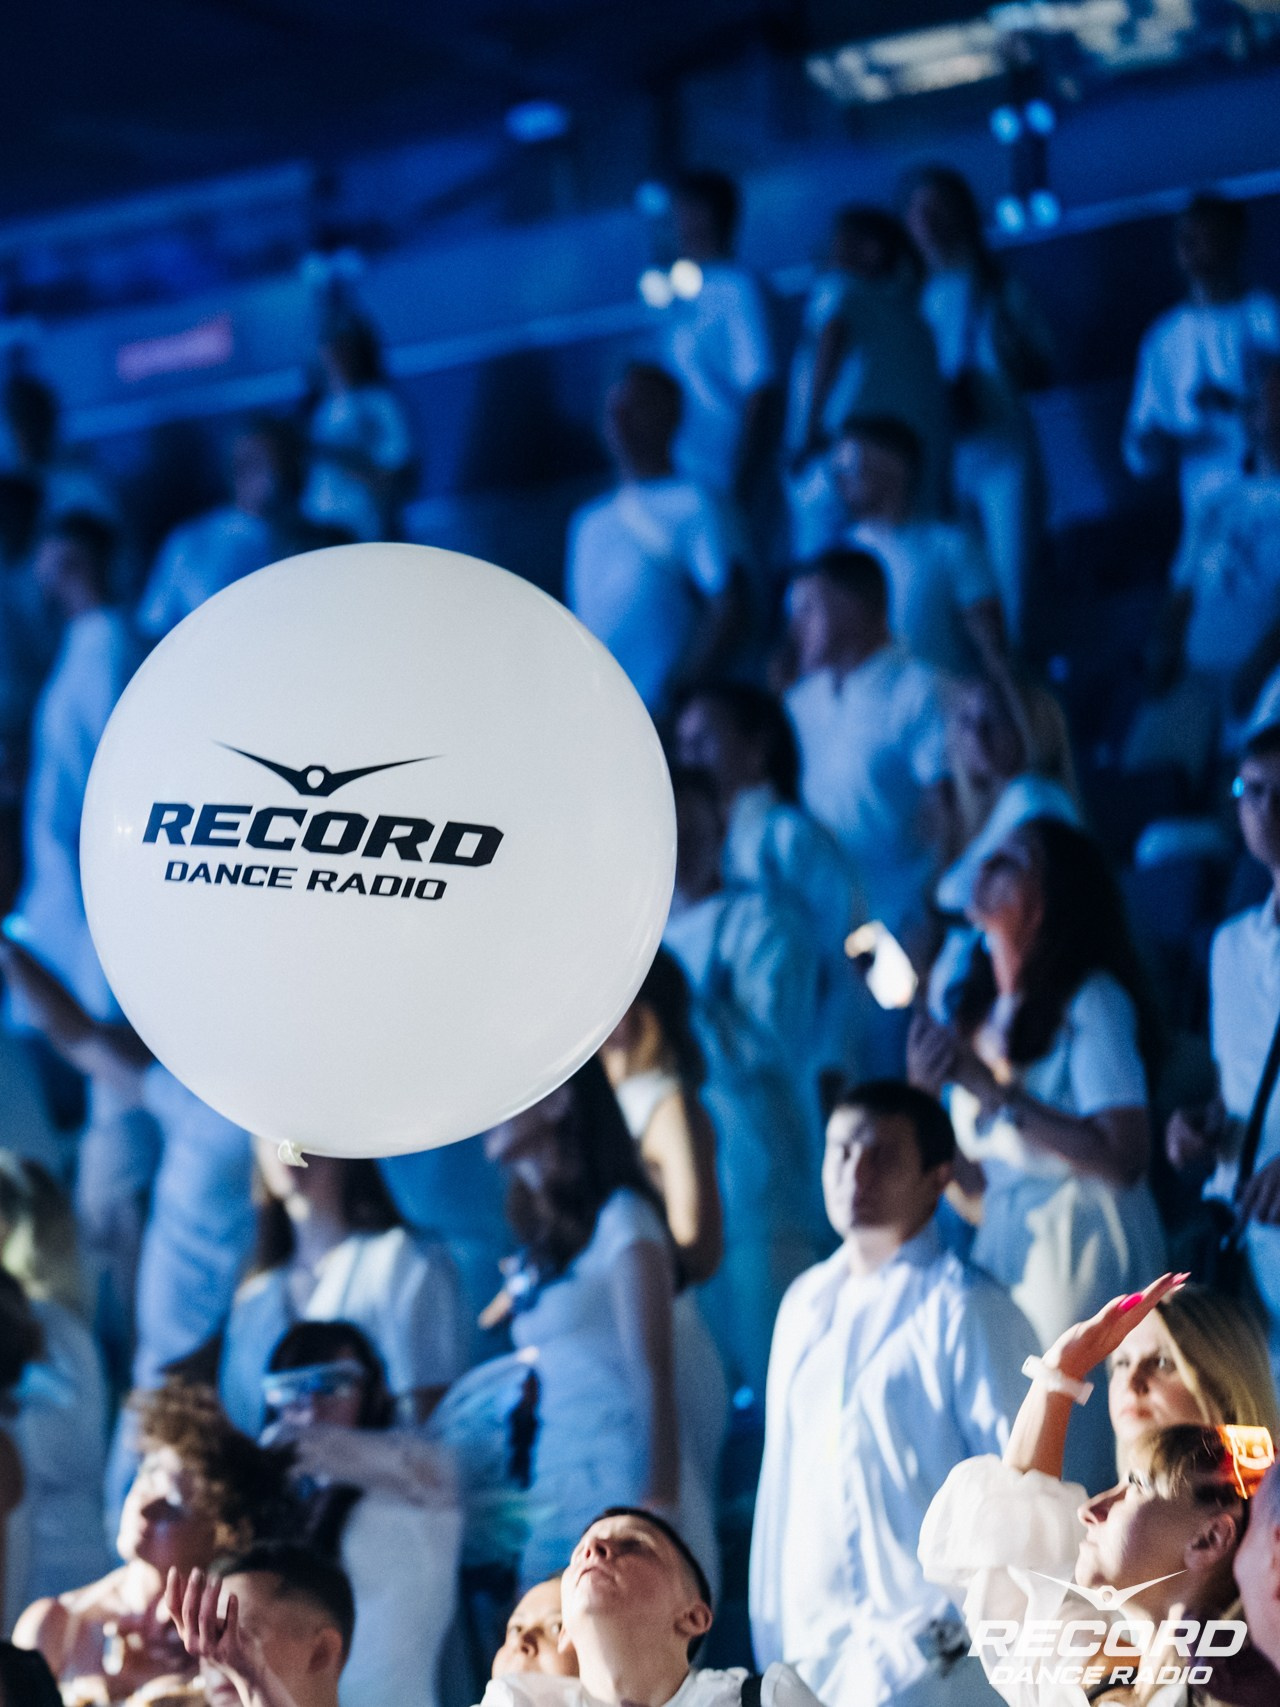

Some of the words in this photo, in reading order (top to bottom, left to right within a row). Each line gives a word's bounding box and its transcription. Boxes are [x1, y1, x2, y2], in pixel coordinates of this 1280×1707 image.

[142, 802, 504, 867] RECORD
[164, 860, 298, 889] DANCE
[306, 870, 447, 900] RADIO
